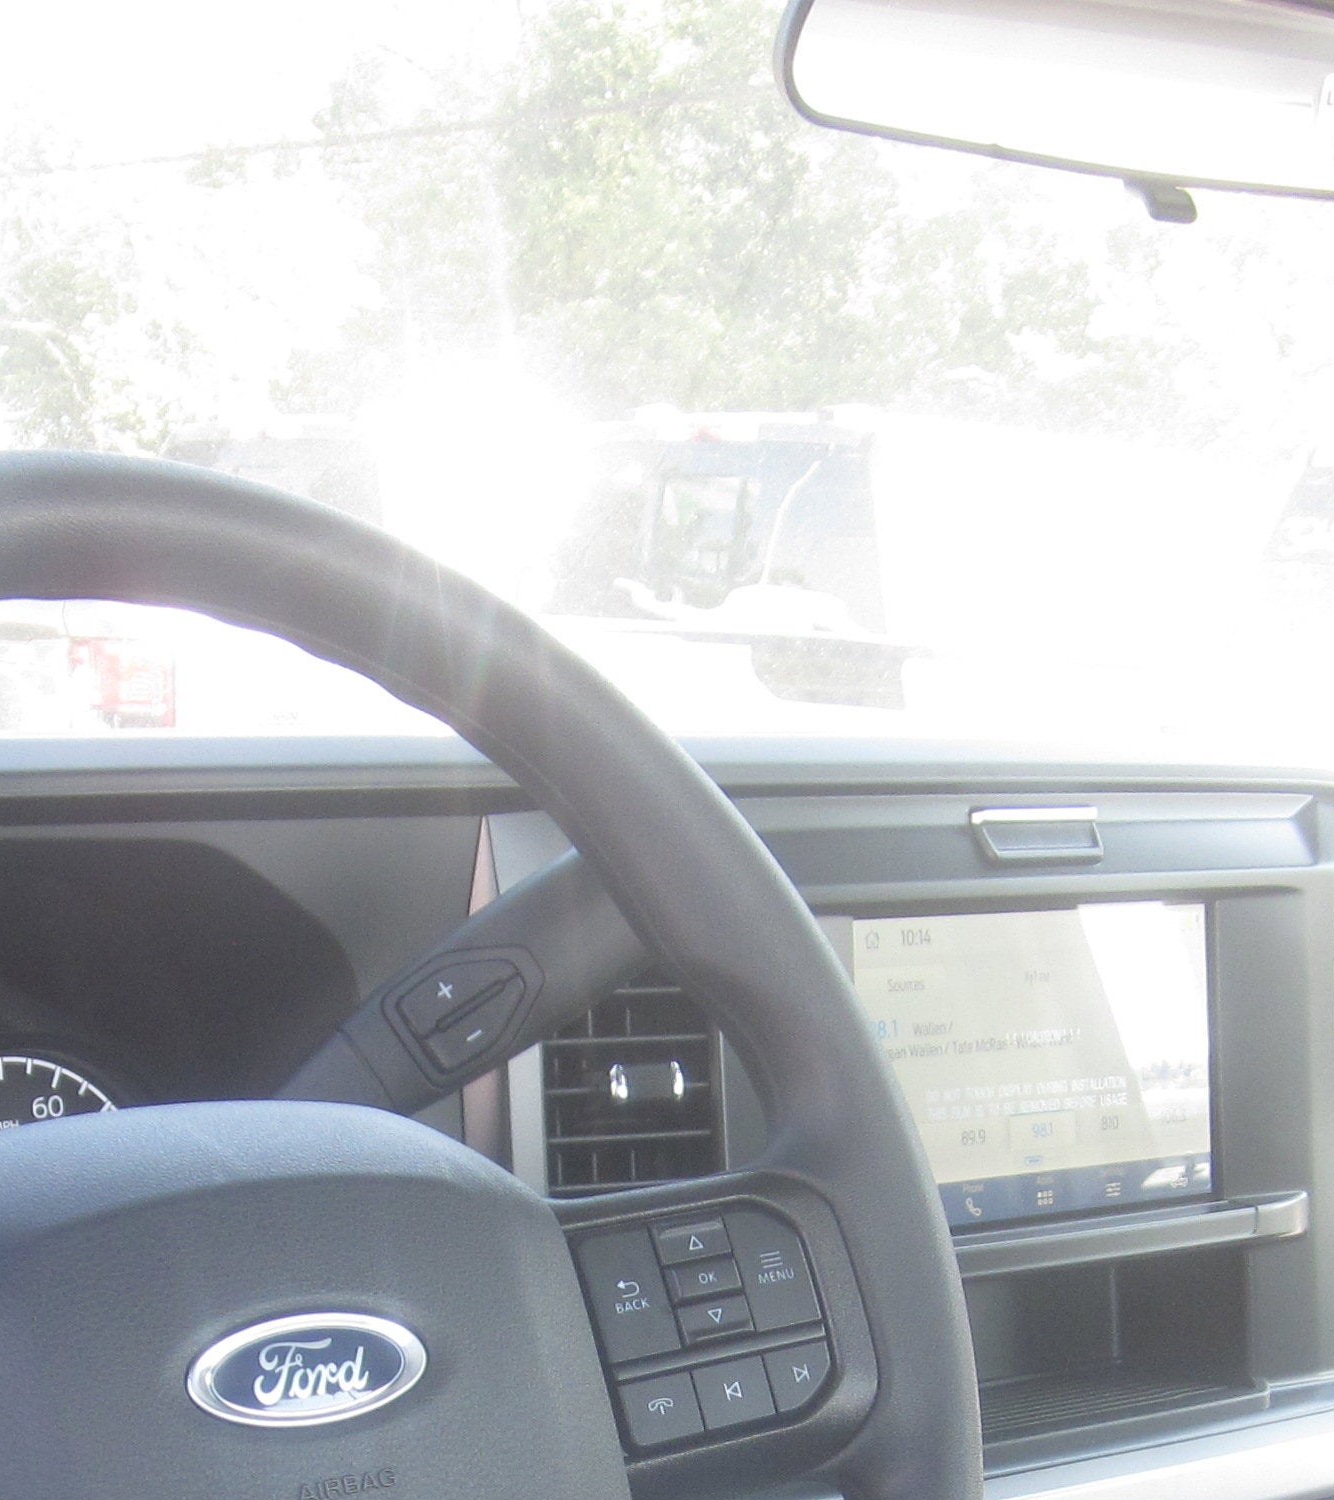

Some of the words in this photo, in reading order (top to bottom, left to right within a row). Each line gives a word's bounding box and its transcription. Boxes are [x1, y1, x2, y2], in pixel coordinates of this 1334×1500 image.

[31, 1094, 64, 1119] 60
[698, 1271, 718, 1285] OK
[758, 1268, 795, 1285] MENU
[615, 1296, 651, 1315] BACK
[253, 1337, 369, 1406] Ford
